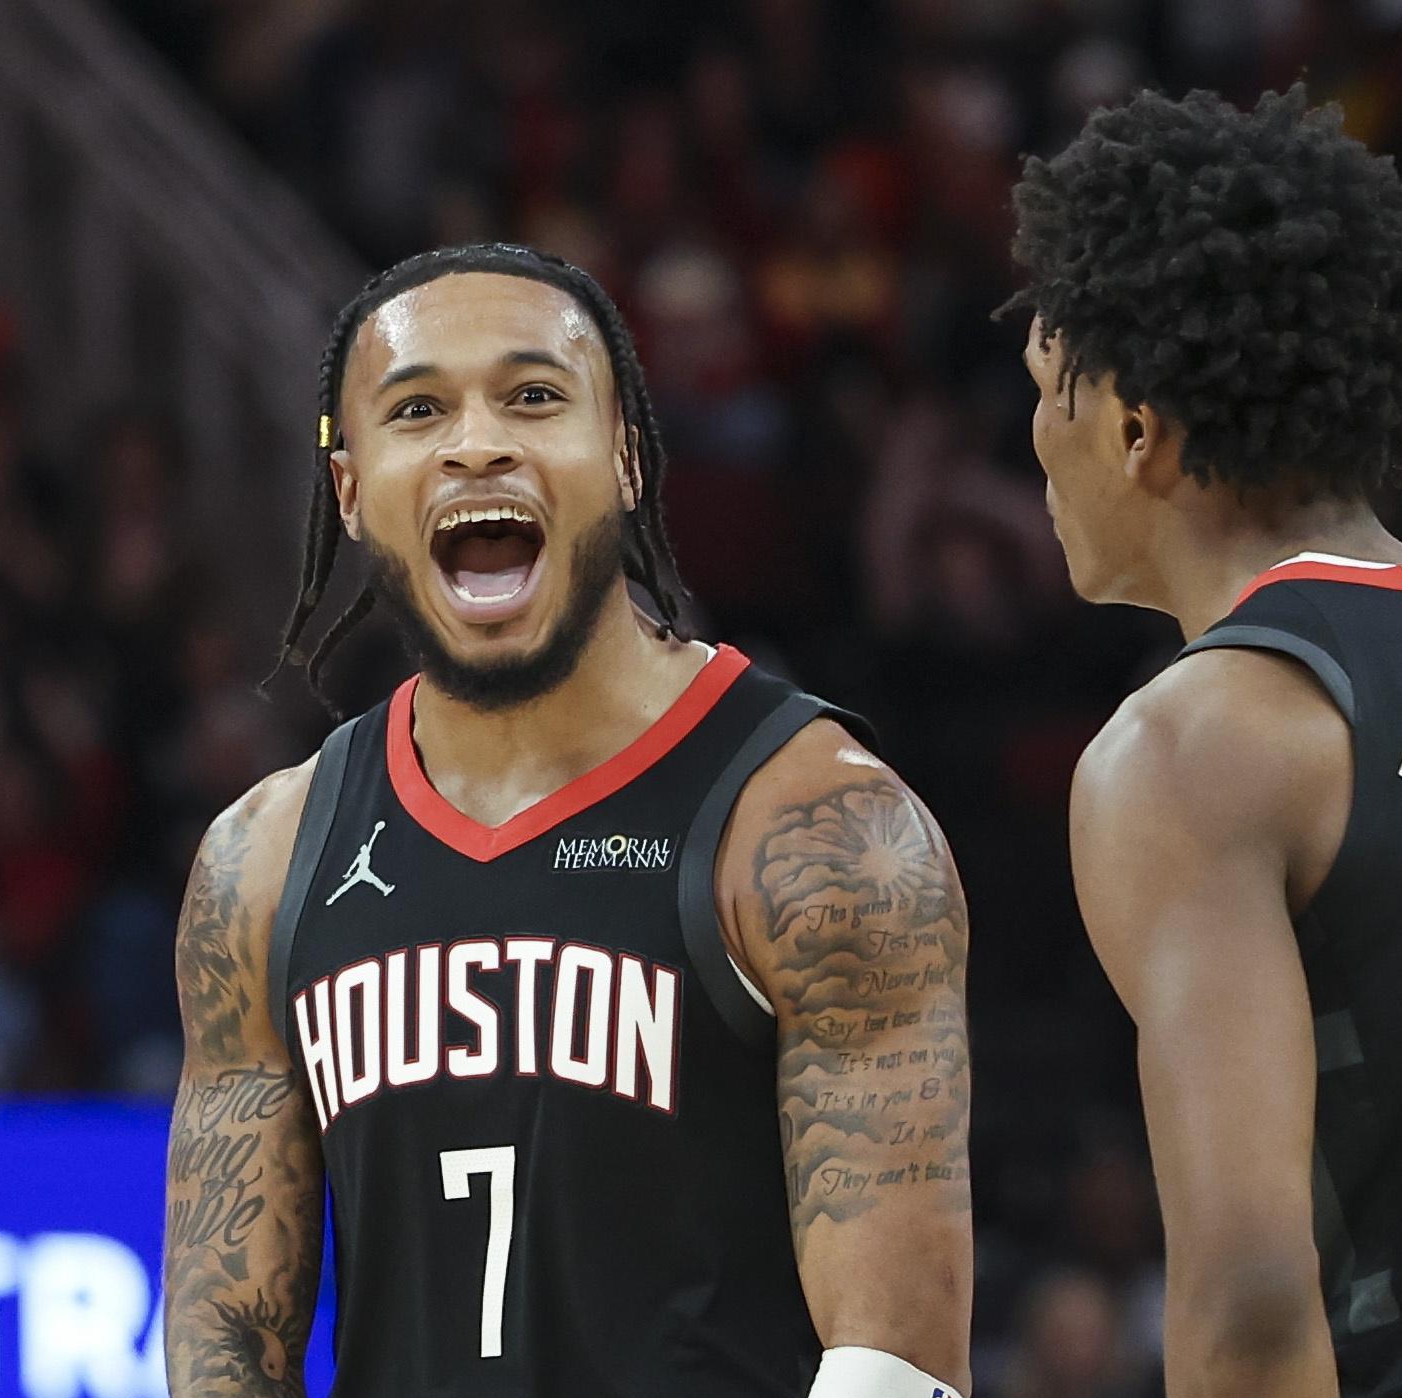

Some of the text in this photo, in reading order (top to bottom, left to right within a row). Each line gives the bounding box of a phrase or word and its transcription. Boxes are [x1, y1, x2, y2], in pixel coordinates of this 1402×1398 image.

[556, 835, 670, 855] MEMORIAL
[554, 852, 668, 869] HERMANN
[294, 937, 679, 1134] HOUSTON
[813, 1014, 857, 1044] Stay
[439, 1145, 516, 1358] 7
